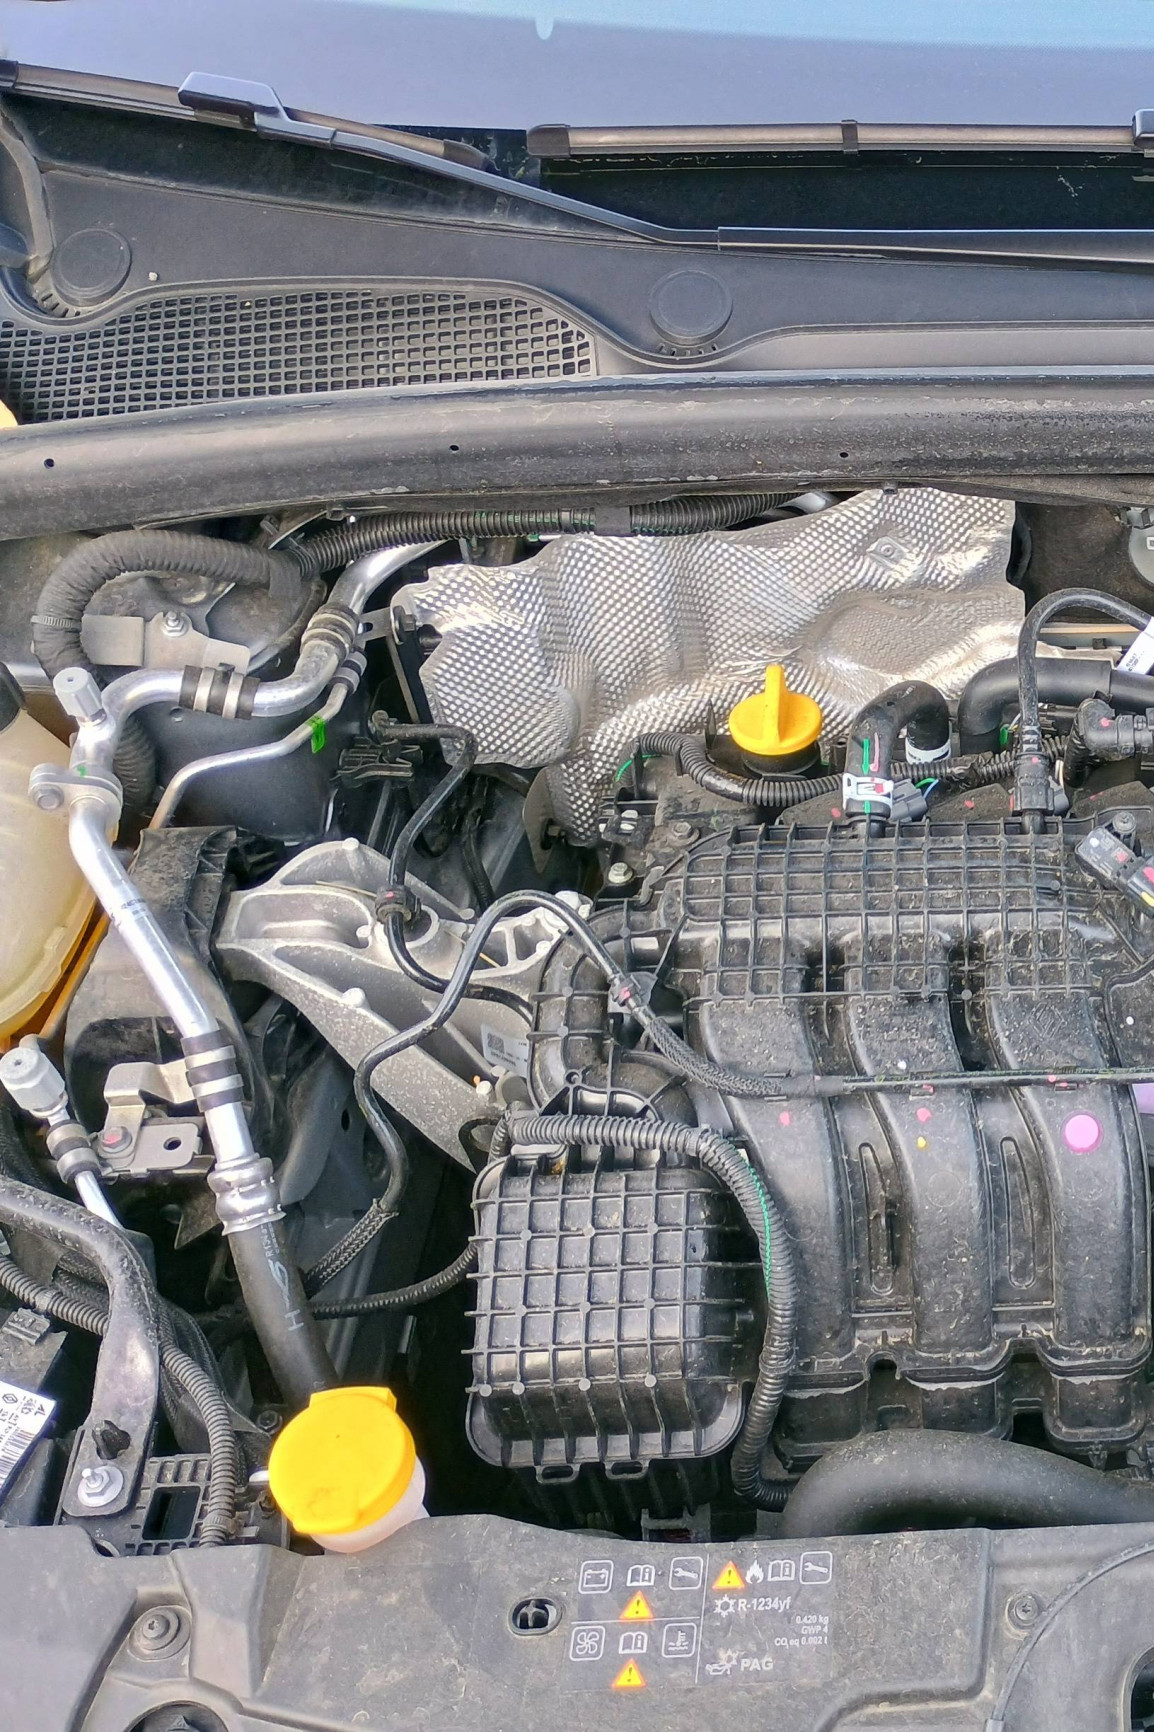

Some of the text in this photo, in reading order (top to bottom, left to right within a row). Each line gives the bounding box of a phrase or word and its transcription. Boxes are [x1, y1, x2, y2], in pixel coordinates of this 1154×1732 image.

[738, 1597, 791, 1612] R-1234yf
[795, 1614, 830, 1625] 0.420 kg
[801, 1624, 829, 1635] GWP 4
[789, 1638, 800, 1648] eq
[800, 1636, 823, 1645] 0.002
[740, 1658, 774, 1672] PAG
